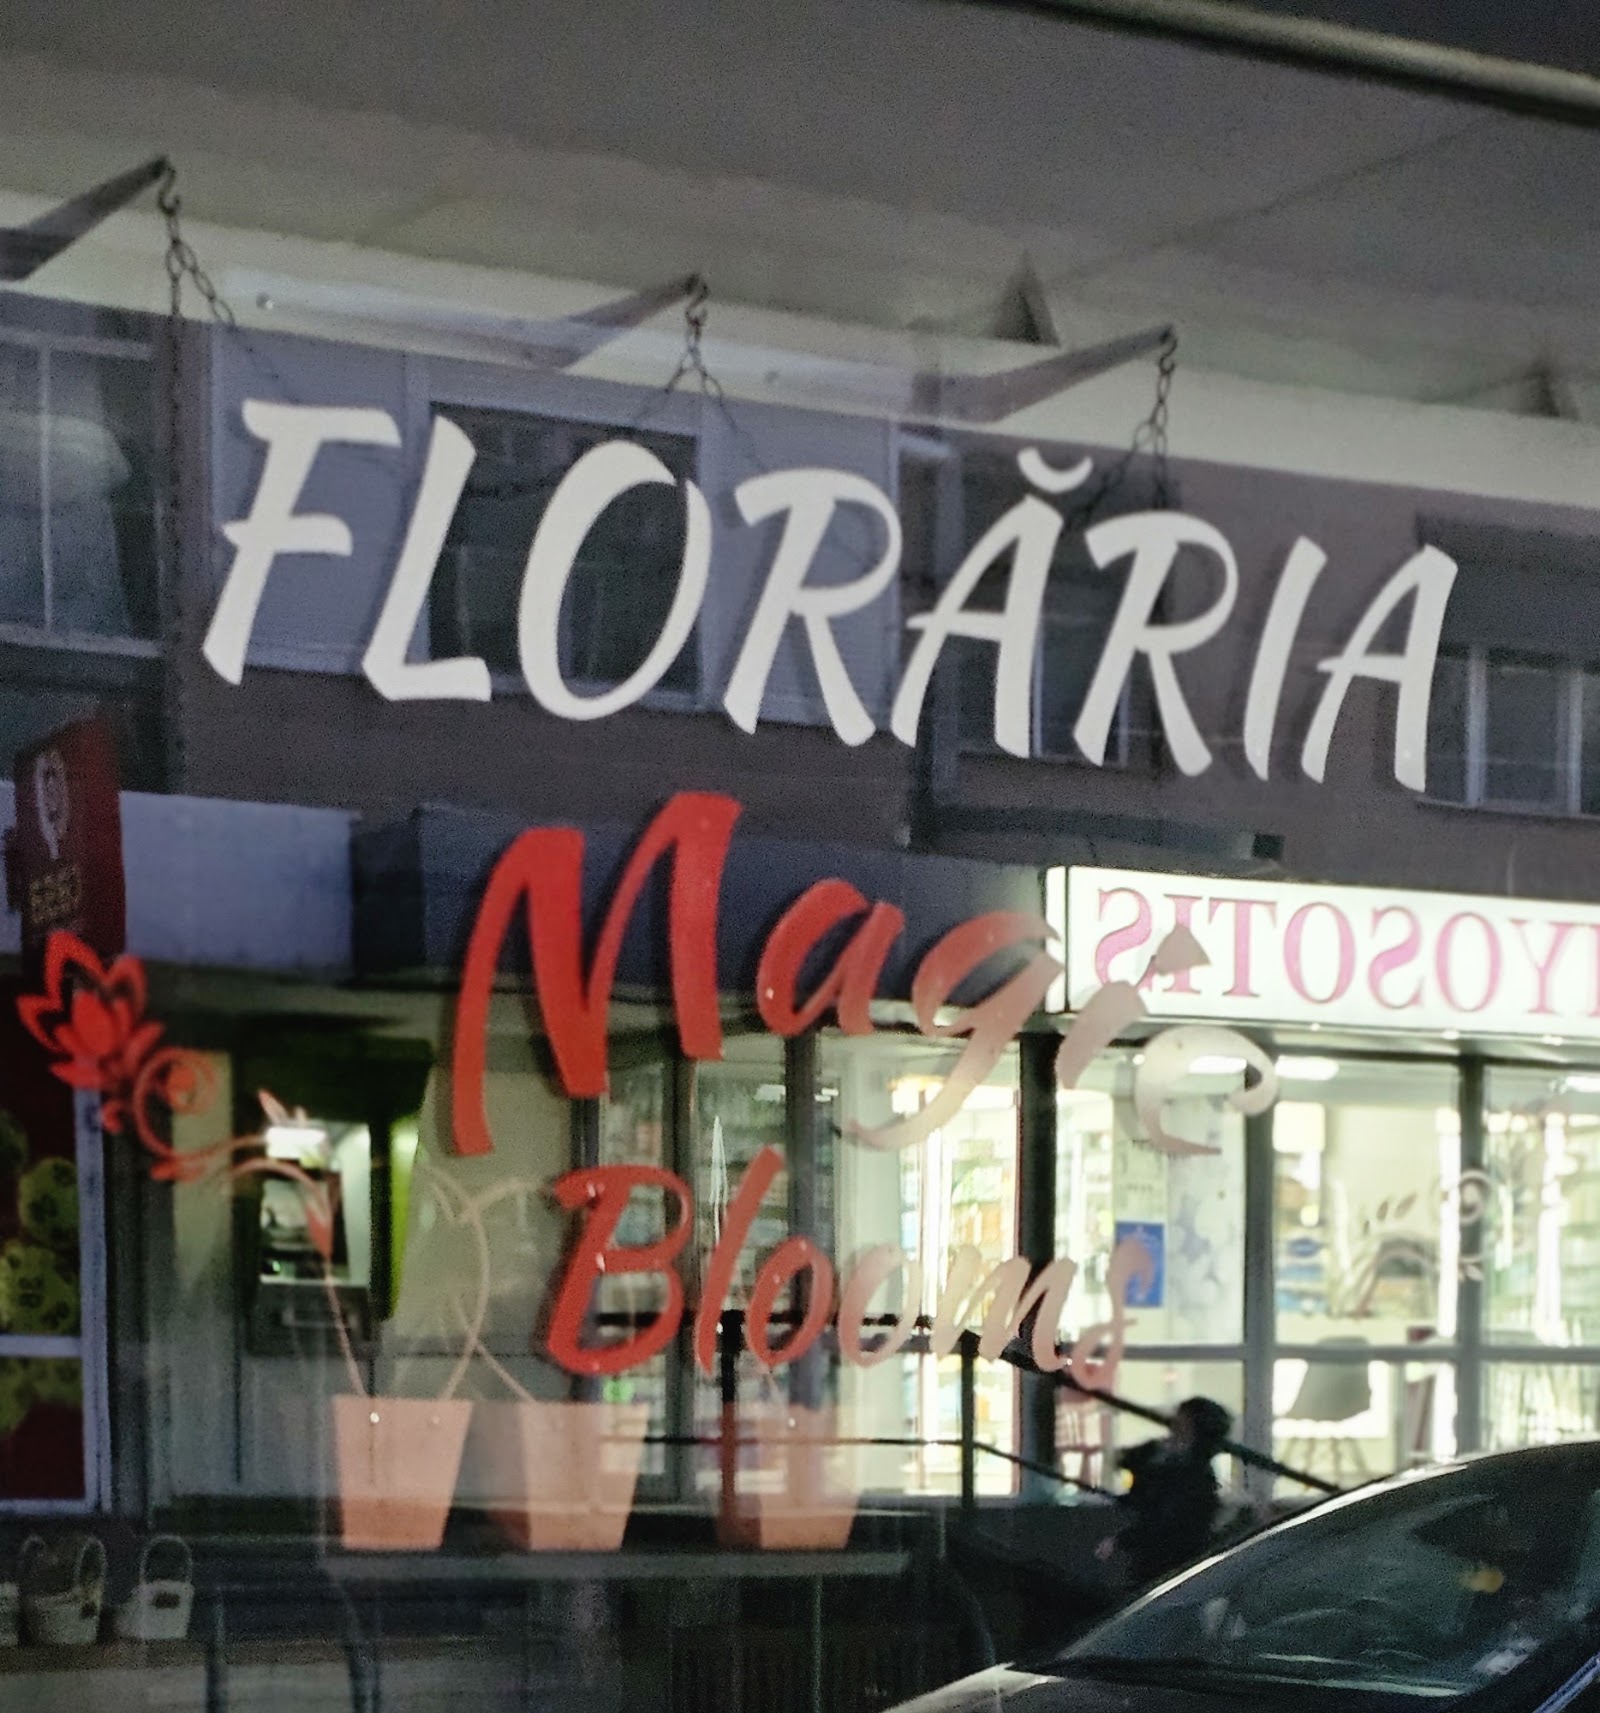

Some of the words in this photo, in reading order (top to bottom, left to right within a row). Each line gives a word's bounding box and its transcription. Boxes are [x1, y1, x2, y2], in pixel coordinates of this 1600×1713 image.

[202, 399, 1458, 793] FLORĂRIA
[452, 790, 1279, 1156] Magic
[543, 1145, 1154, 1391] Blooms
